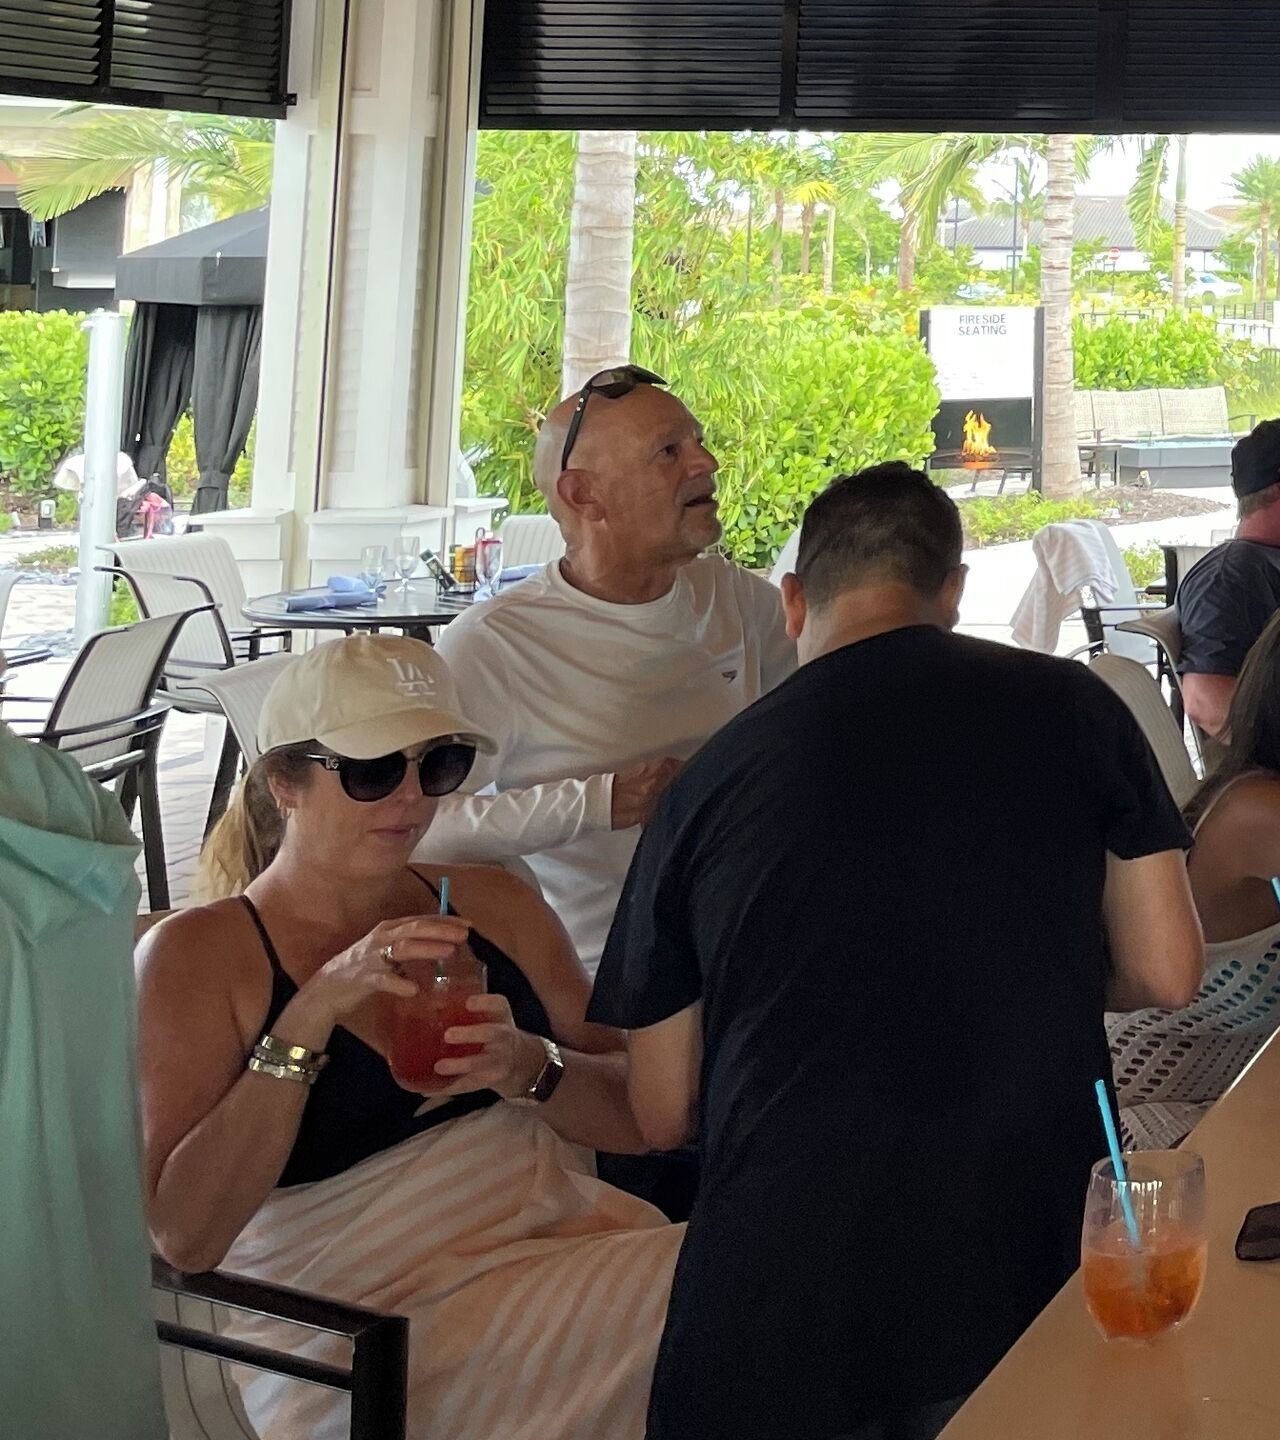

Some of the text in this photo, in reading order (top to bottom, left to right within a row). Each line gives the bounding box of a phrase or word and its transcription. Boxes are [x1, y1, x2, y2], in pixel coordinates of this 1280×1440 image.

[958, 313, 1007, 325] FIRESIDE
[958, 324, 1007, 336] SEATING
[385, 657, 437, 697] LA
